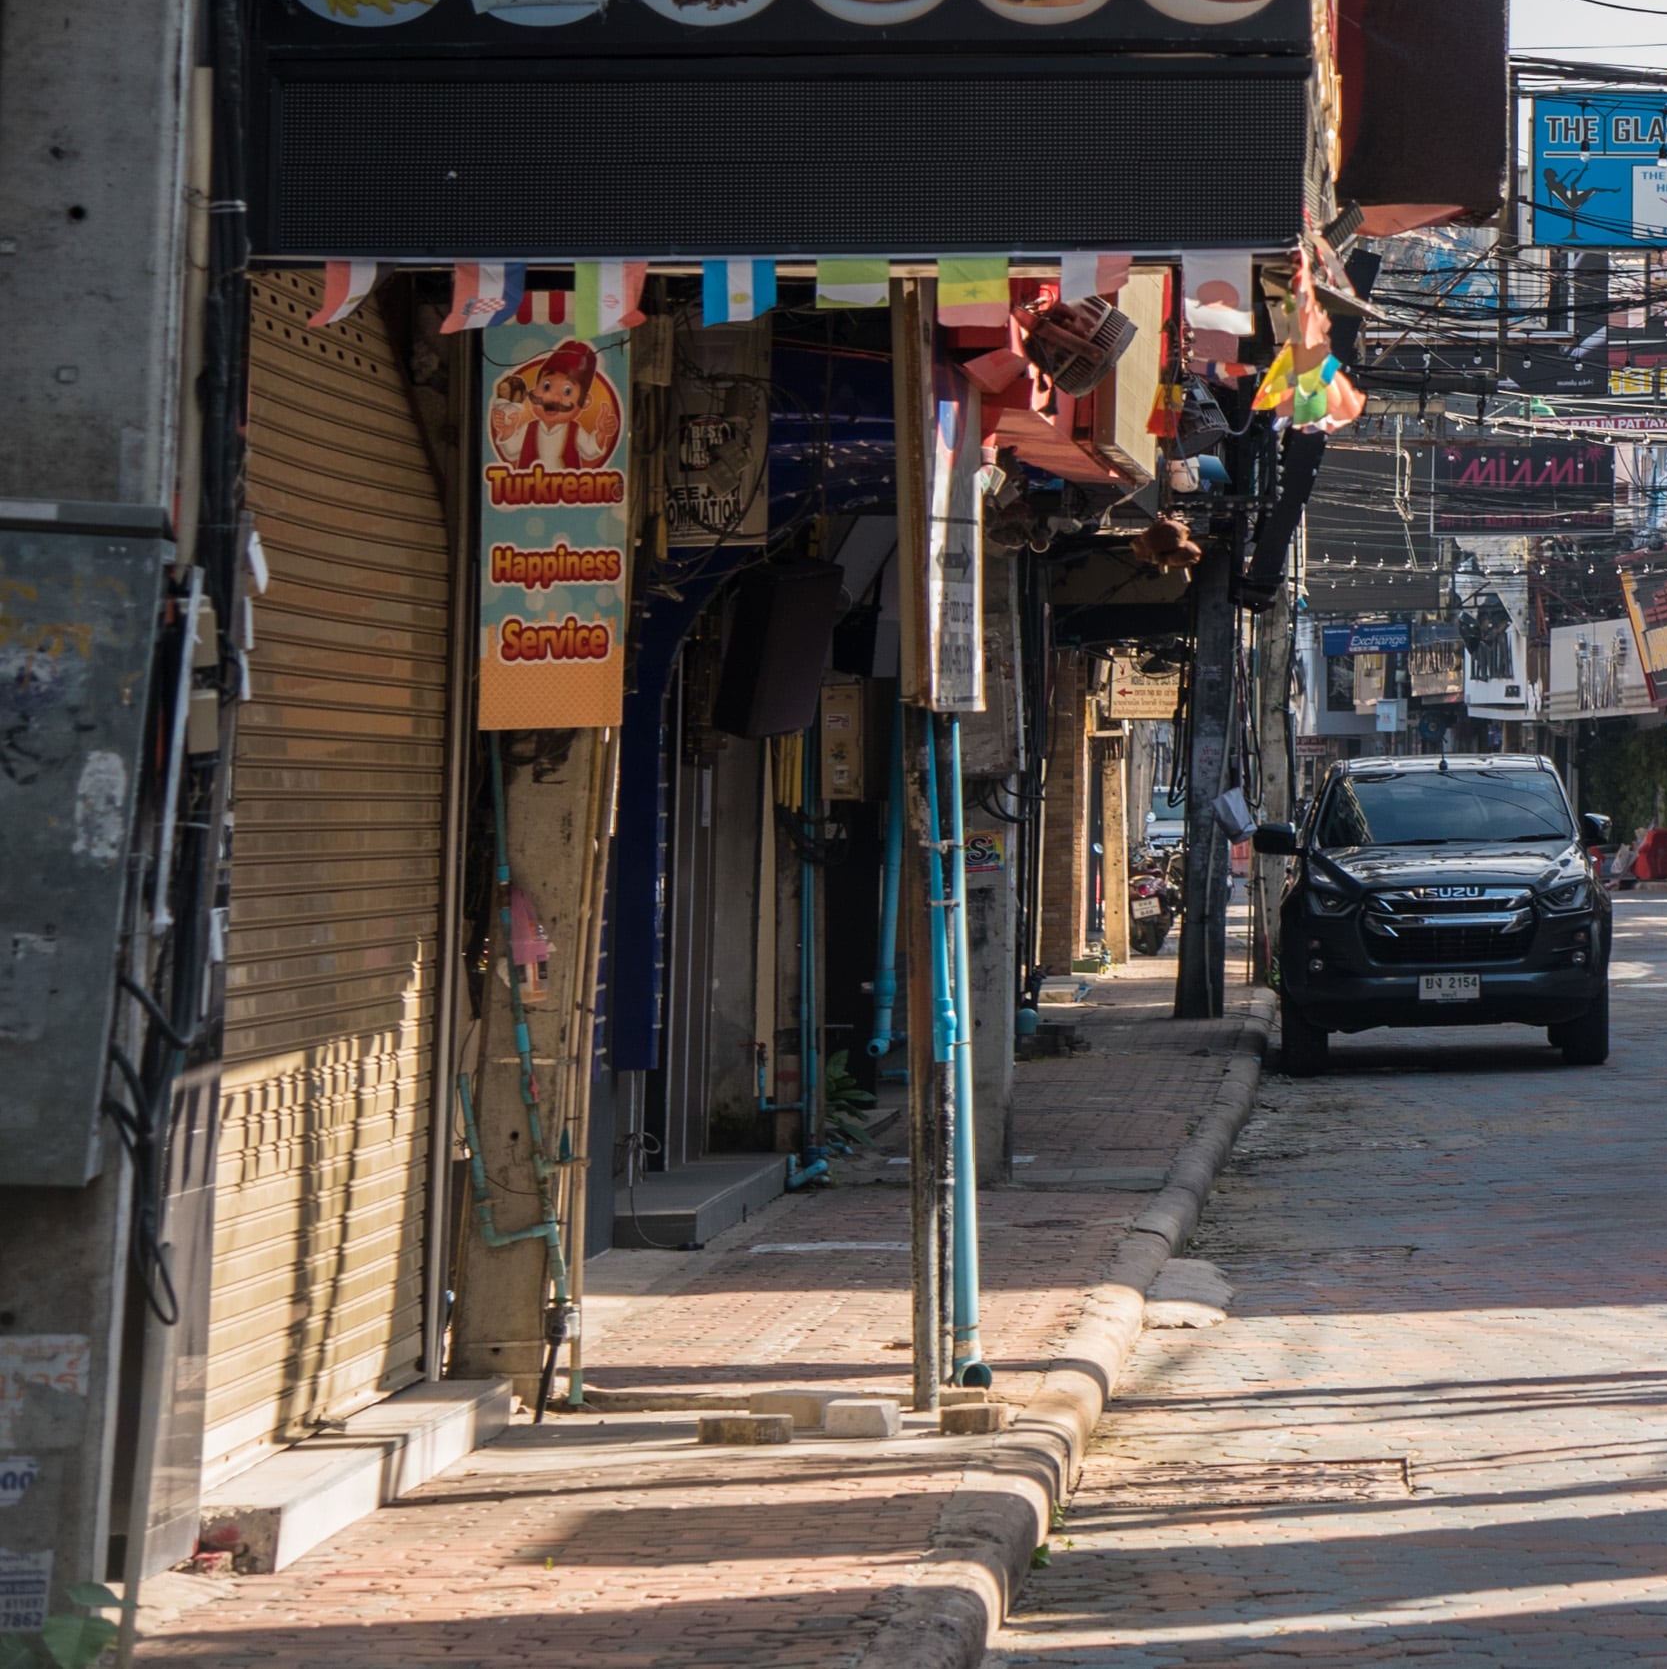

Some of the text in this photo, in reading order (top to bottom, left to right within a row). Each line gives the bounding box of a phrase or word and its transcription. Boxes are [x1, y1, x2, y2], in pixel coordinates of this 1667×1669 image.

[1544, 115, 1600, 144] THE
[1641, 171, 1666, 181] THE
[487, 468, 624, 505] Turkream
[491, 546, 621, 587] Happiness
[500, 619, 609, 661] Service
[1350, 635, 1408, 648] Exchange
[1420, 886, 1479, 898] ISUZU
[1448, 976, 1478, 989] 2154
